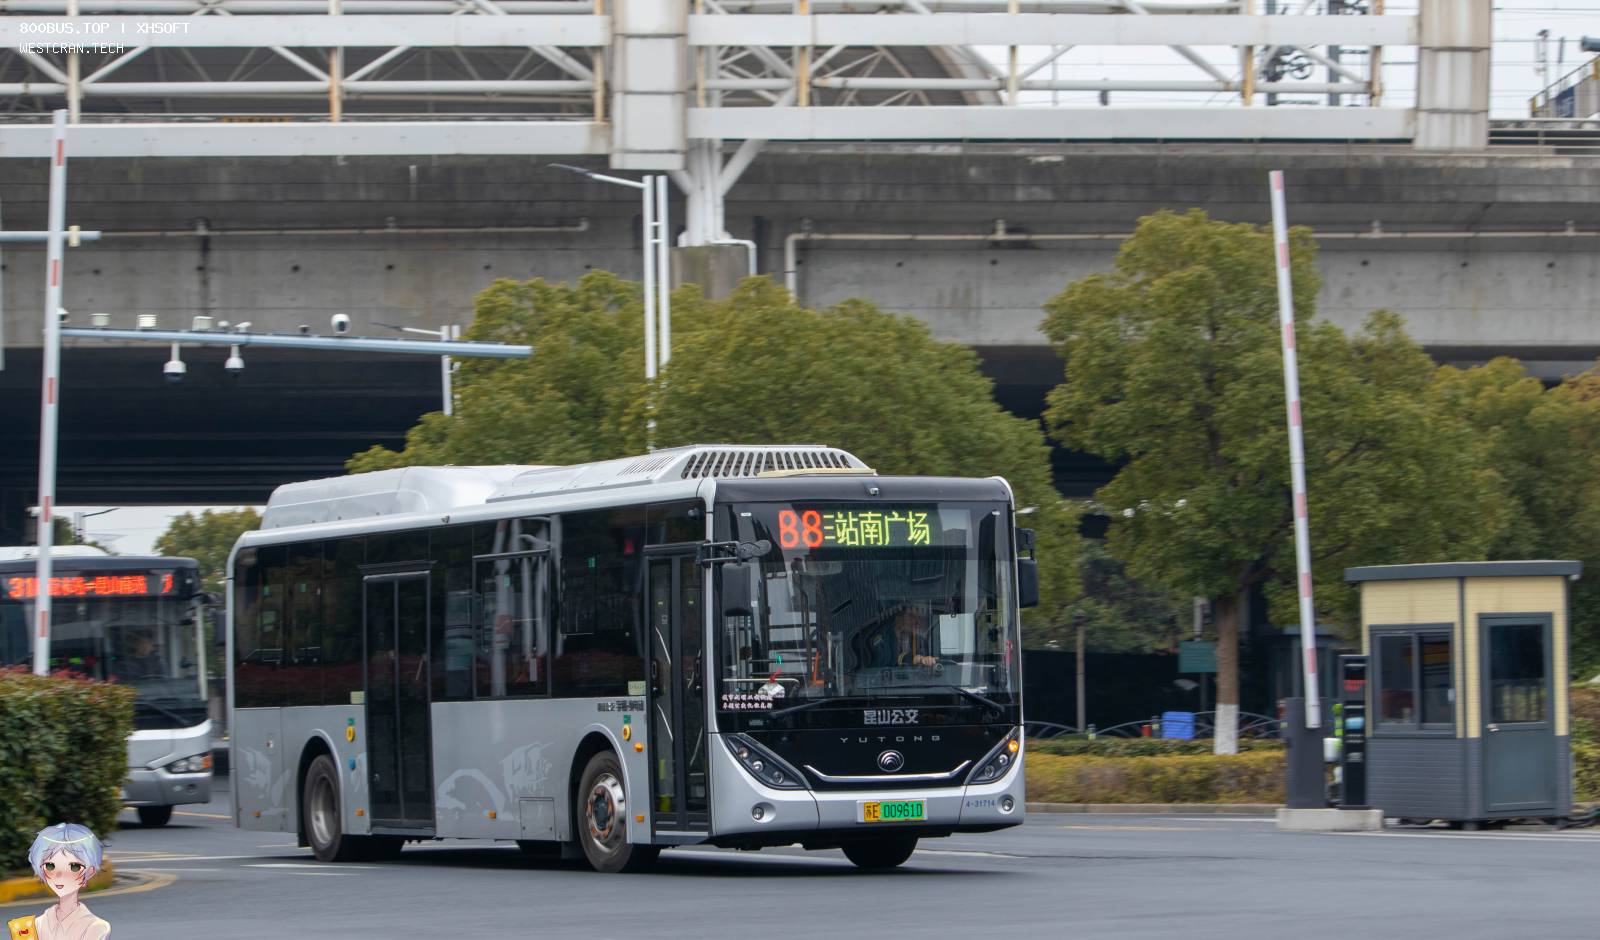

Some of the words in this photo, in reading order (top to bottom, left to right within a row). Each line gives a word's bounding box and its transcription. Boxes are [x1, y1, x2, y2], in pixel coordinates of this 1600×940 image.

[863, 709, 919, 725] 昆山公交
[840, 735, 940, 743] YUTONG
